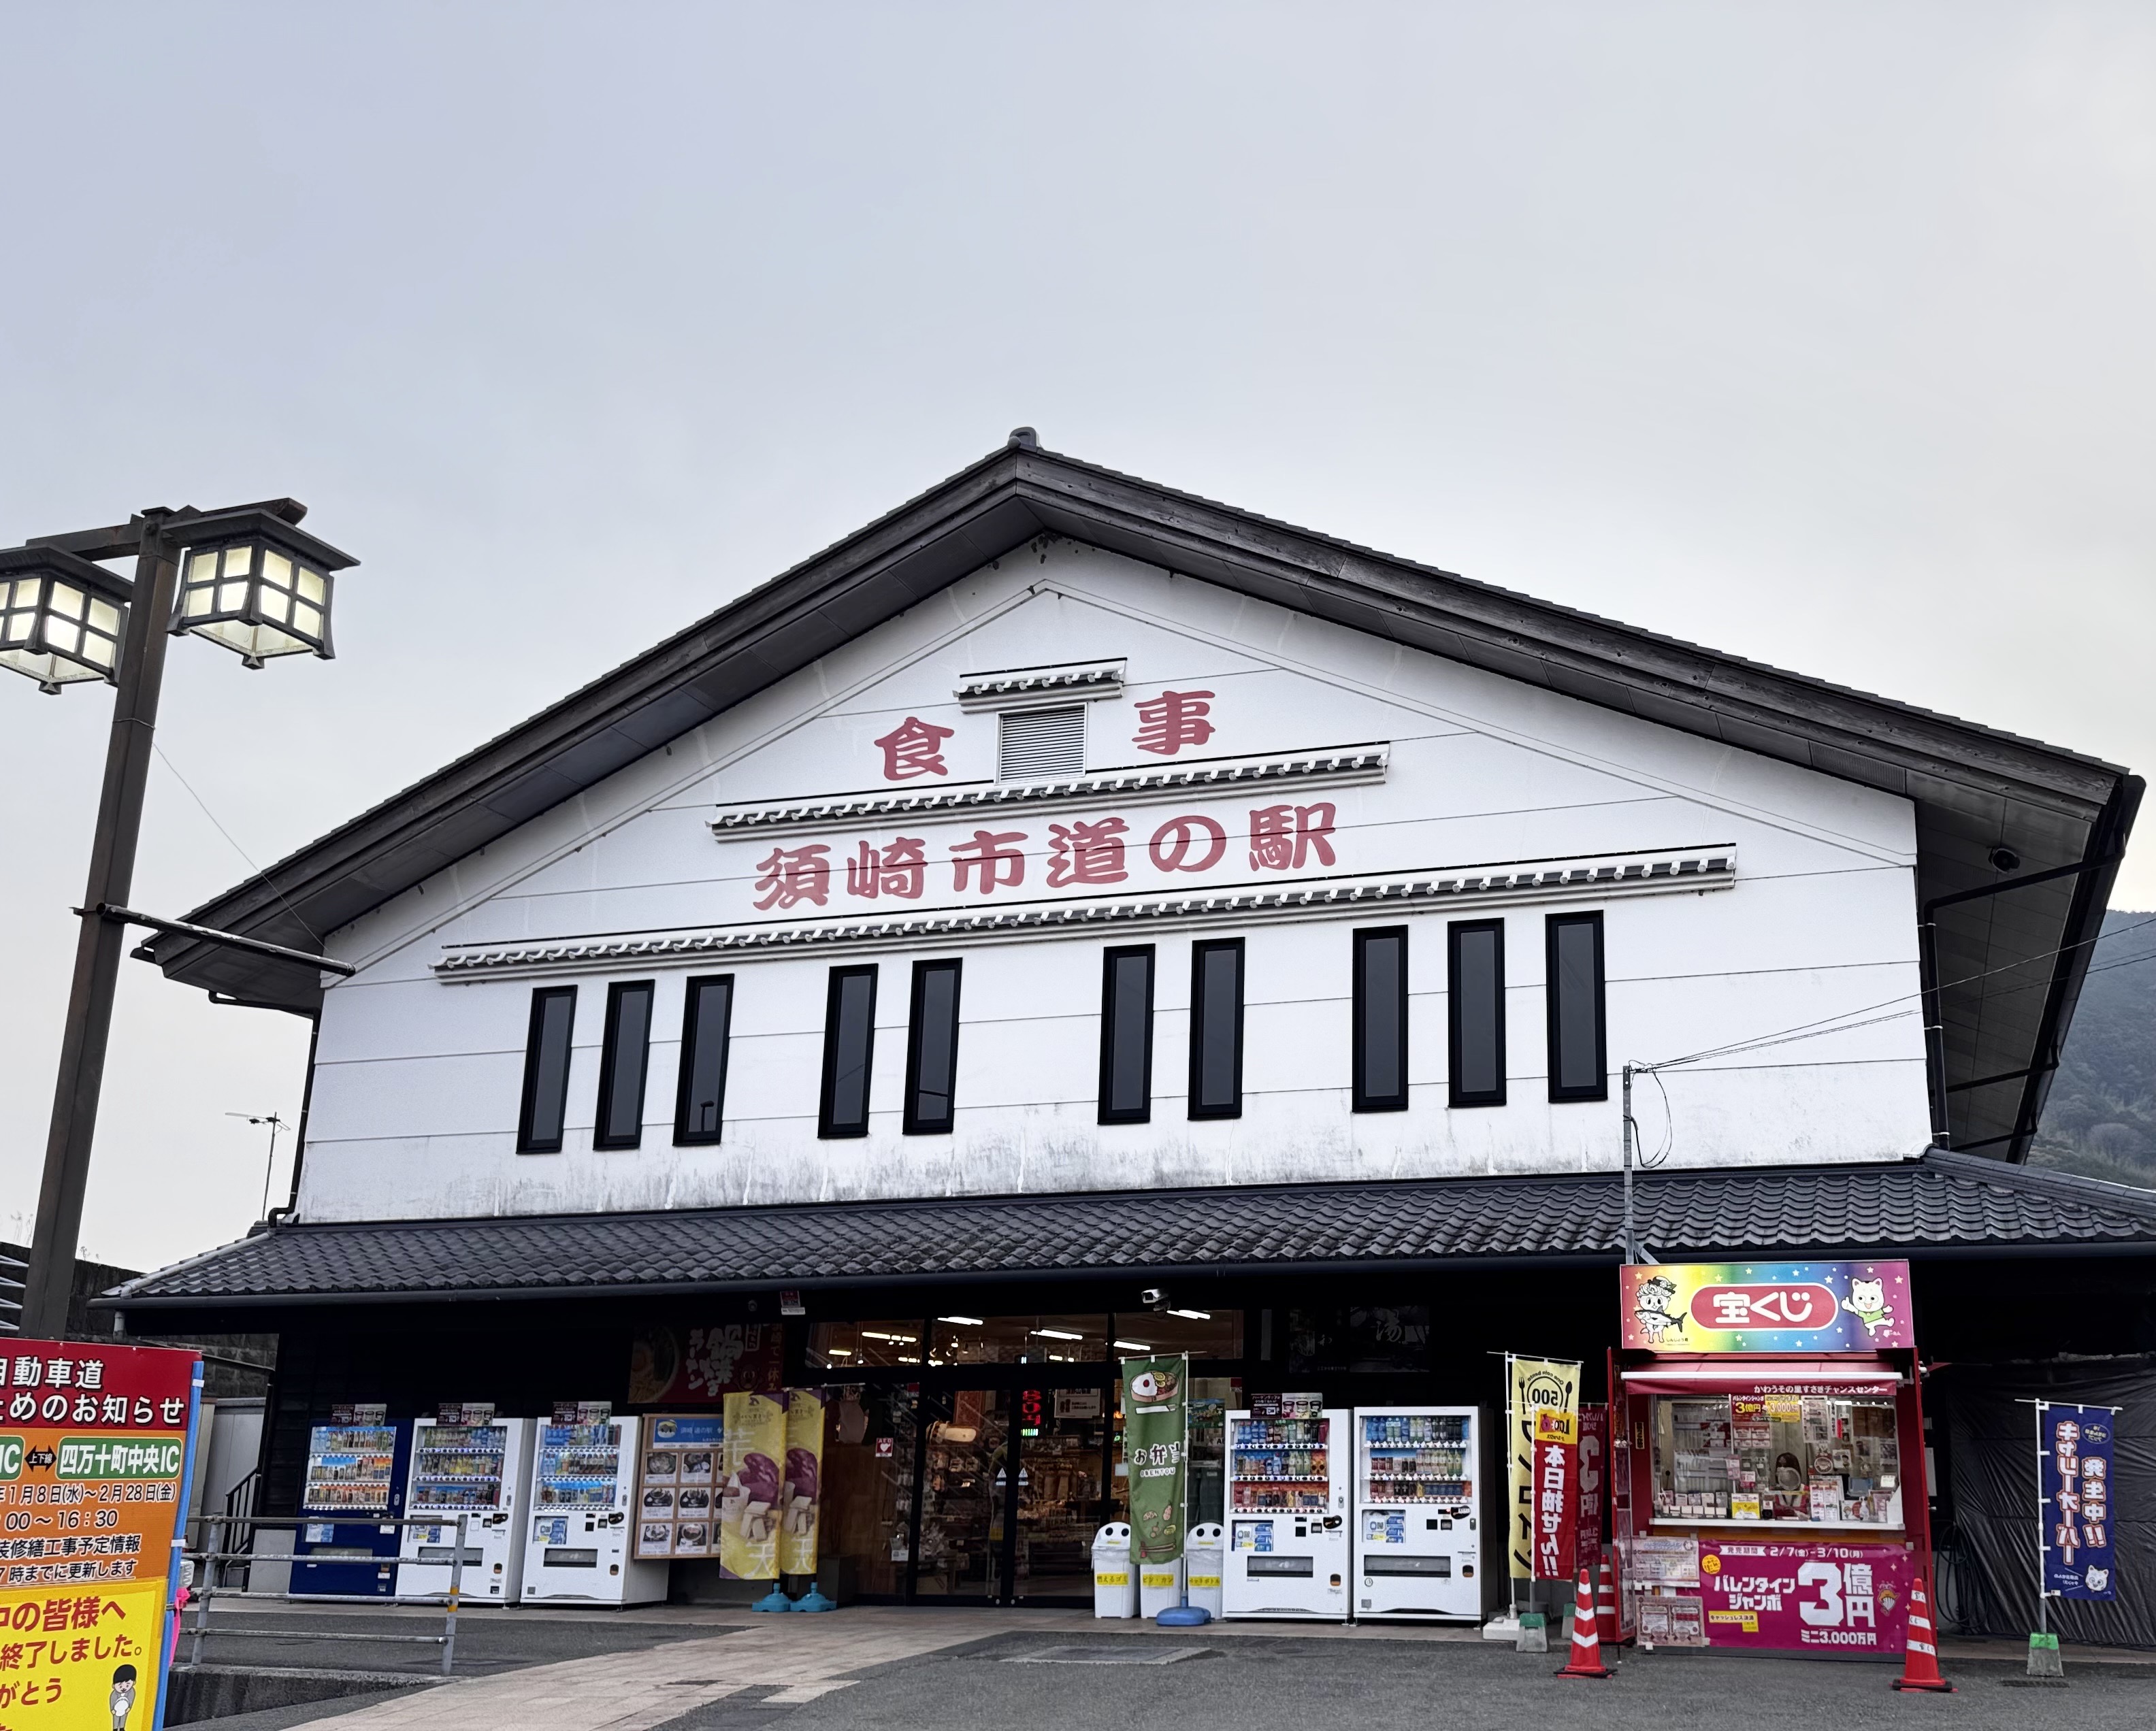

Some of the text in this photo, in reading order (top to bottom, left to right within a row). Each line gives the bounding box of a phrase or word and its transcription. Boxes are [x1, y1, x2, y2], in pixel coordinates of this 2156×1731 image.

[753, 802, 1337, 912] 須崎市道の駅
[1712, 1291, 1813, 1324] 宝くじ
[0, 1392, 185, 1424] めのお知らせ
[29, 1453, 53, 1464] 上下線
[59, 1444, 180, 1475] 四万十町中央IC
[1714, 1575, 1795, 1594] バレンタイン
[1729, 1593, 1782, 1612] ジャンボ
